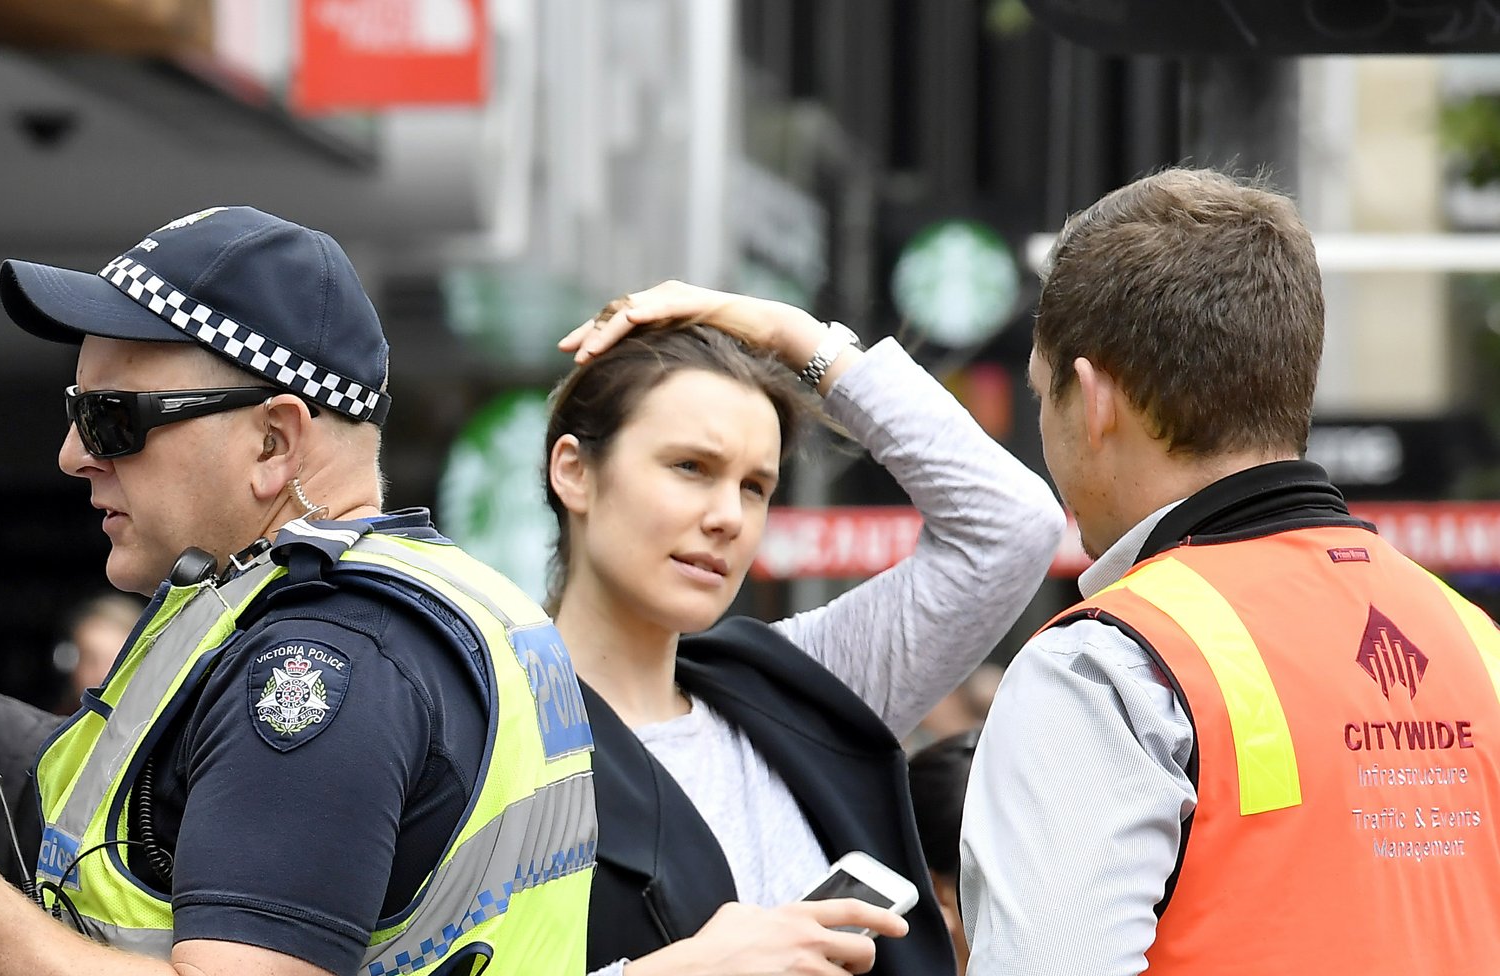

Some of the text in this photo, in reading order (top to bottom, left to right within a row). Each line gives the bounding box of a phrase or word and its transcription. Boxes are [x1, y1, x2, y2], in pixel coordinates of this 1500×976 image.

[256, 645, 346, 671] VICTORIA POLICE
[1344, 721, 1475, 751] CITYWIDE
[1357, 763, 1468, 787] Infrastructure
[1351, 806, 1481, 831] Traffic & Events
[1373, 836, 1466, 863] Management
